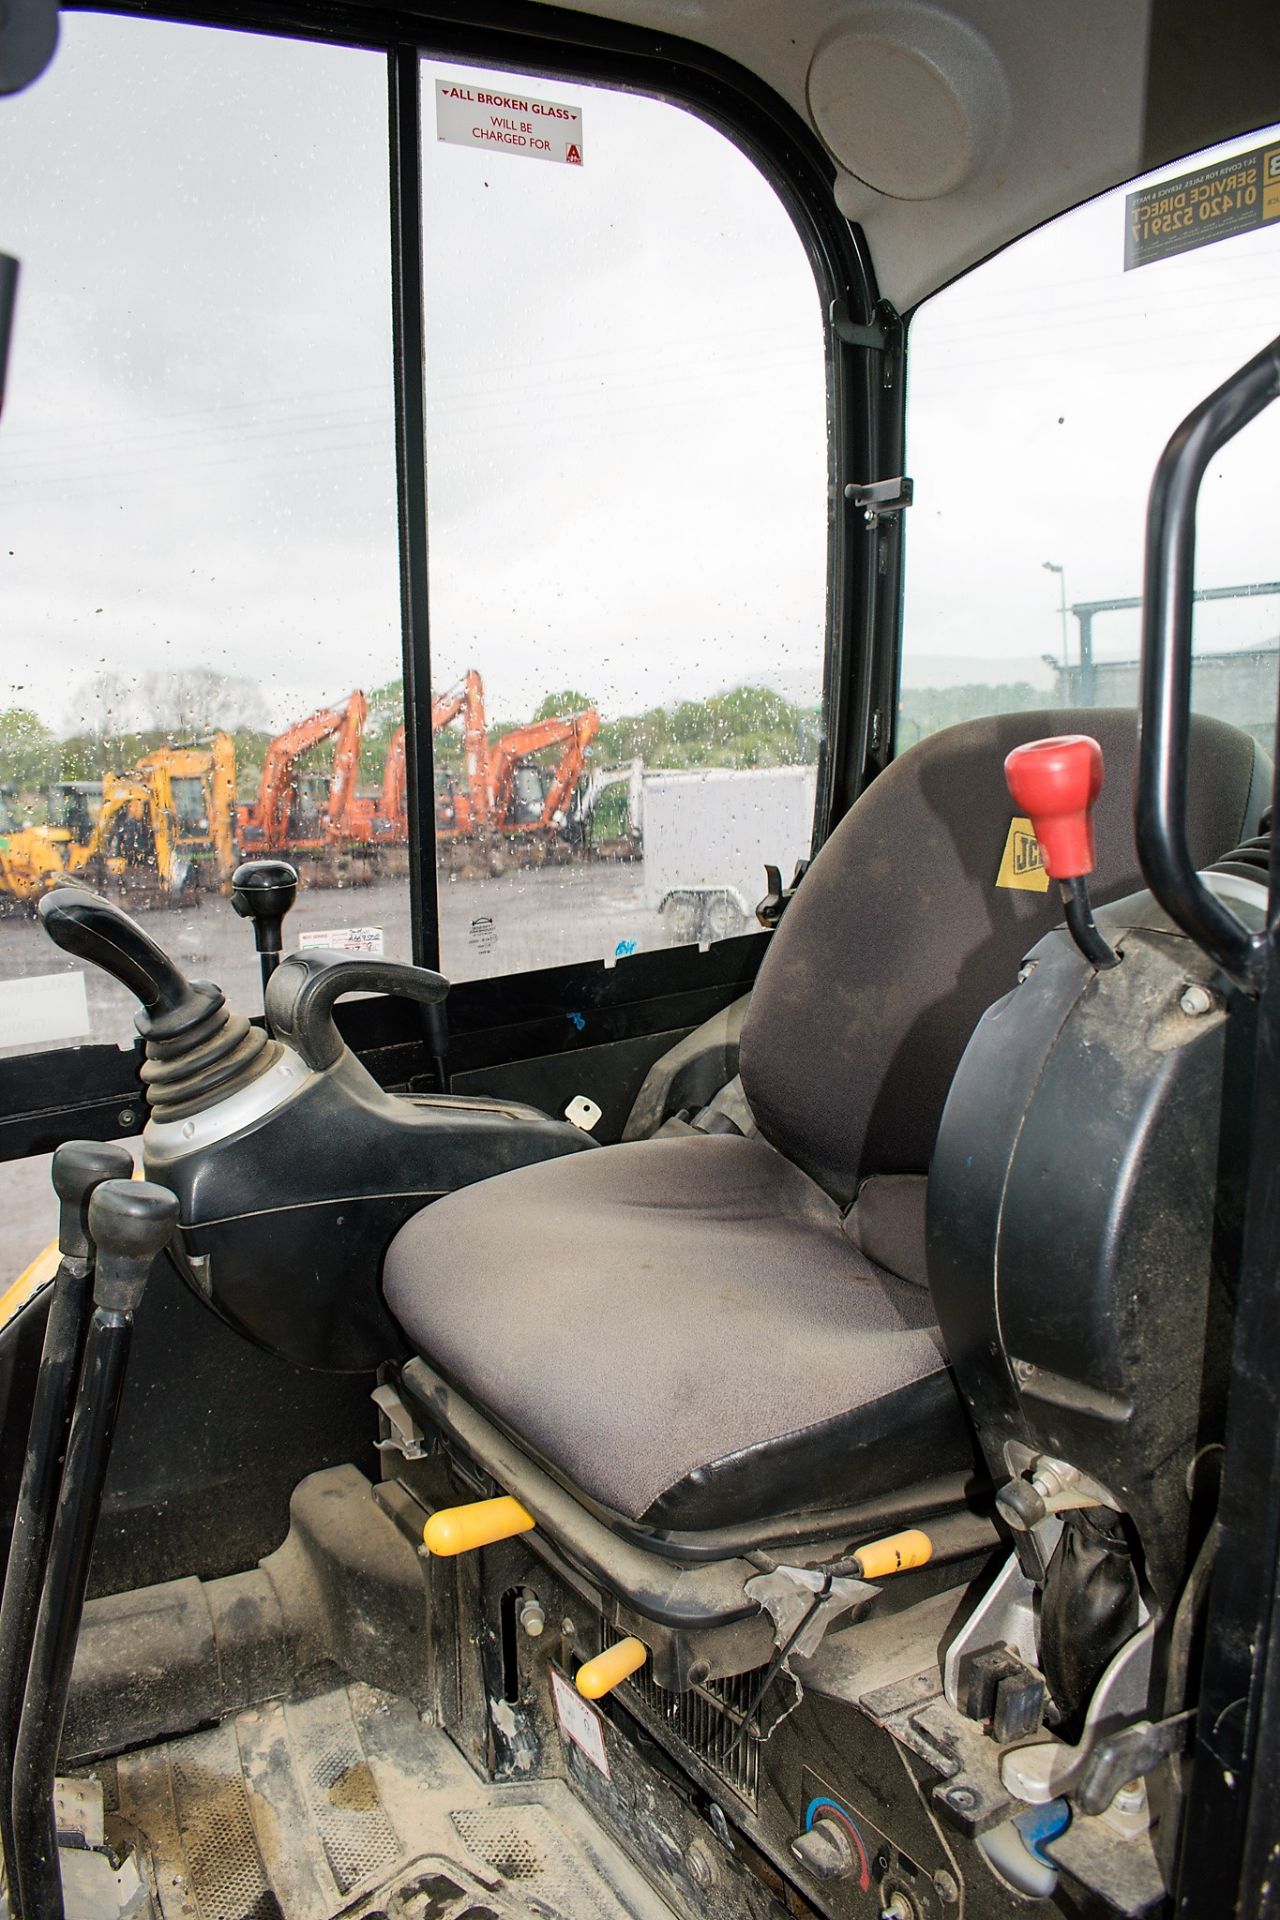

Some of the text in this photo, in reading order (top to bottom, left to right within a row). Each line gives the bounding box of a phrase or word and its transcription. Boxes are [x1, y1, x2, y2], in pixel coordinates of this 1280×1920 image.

[450, 88, 569, 120] ALL BROKEN GLASS
[490, 116, 532, 134] WILL BE
[472, 127, 551, 151] CHARGED FOR
